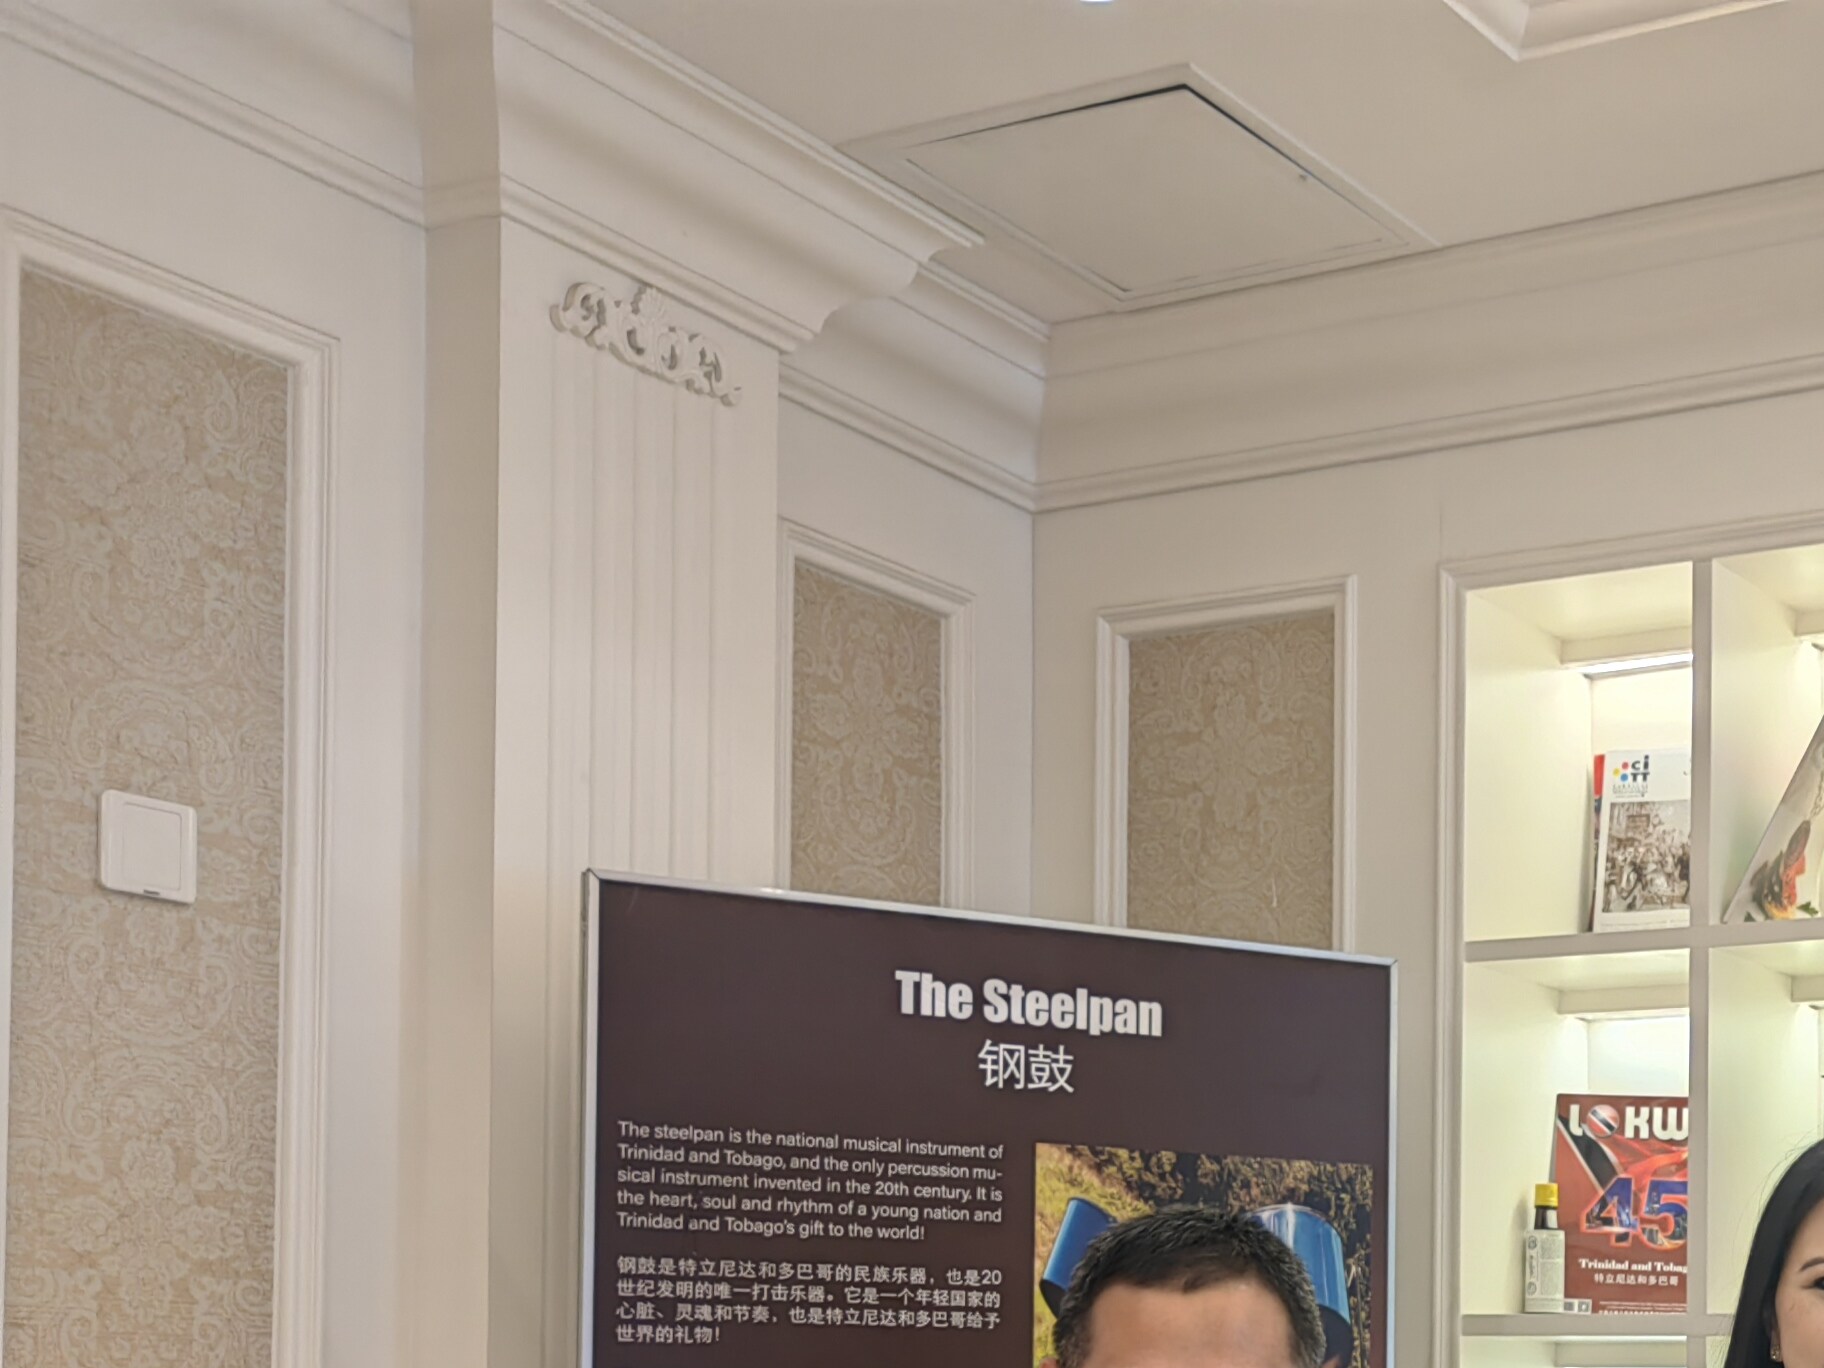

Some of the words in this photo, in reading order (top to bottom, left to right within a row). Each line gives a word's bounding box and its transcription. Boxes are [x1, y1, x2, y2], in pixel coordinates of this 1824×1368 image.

[895, 970, 973, 1020] The
[983, 977, 1162, 1037] Steelpan
[978, 1039, 1075, 1094] 钢鼓
[619, 1122, 650, 1137] The
[654, 1124, 724, 1143] steelpan
[728, 1128, 741, 1143] is
[746, 1129, 772, 1145] the
[775, 1133, 838, 1148] national
[843, 1137, 901, 1152] musical
[905, 1139, 985, 1158] instrument
[988, 1144, 1003, 1159] of
[618, 1145, 684, 1162] Trinidad
[688, 1150, 719, 1164] and
[725, 1151, 786, 1170] Tobago,
[789, 1155, 820, 1170] and
[823, 1156, 848, 1171] the
[852, 1158, 884, 1177] only
[887, 1162, 969, 1178] percussion
[972, 1167, 1002, 1180] mu-
[617, 1169, 654, 1182] sical
[660, 1170, 748, 1187] instrument
[753, 1175, 821, 1191] invented
[826, 1178, 840, 1192] in
[845, 1179, 870, 1194] the
[874, 1181, 908, 1195] 20th
[913, 1184, 971, 1202] century.
[976, 1186, 986, 1200] It
[990, 1186, 1002, 1201] is
[616, 1190, 644, 1205] the
[649, 1191, 697, 1209] heart,
[702, 1195, 736, 1209] soul
[740, 1197, 771, 1211] and
[776, 1197, 833, 1216] rhythm
[837, 1200, 854, 1214] of
[857, 1204, 866, 1216] a
[871, 1205, 918, 1222] young
[923, 1205, 969, 1220] nation
[973, 1207, 1001, 1222] and
[1579, 1174, 1688, 1250] 45
[618, 1212, 683, 1229] Trinidad
[688, 1216, 719, 1231] and
[724, 1217, 794, 1236] Tobago's
[798, 1220, 824, 1238] gift
[828, 1222, 844, 1236] to
[848, 1222, 872, 1238] the
[876, 1224, 924, 1239] world!
[1578, 1258, 1629, 1270] Trinidad
[1631, 1261, 1652, 1272] and
